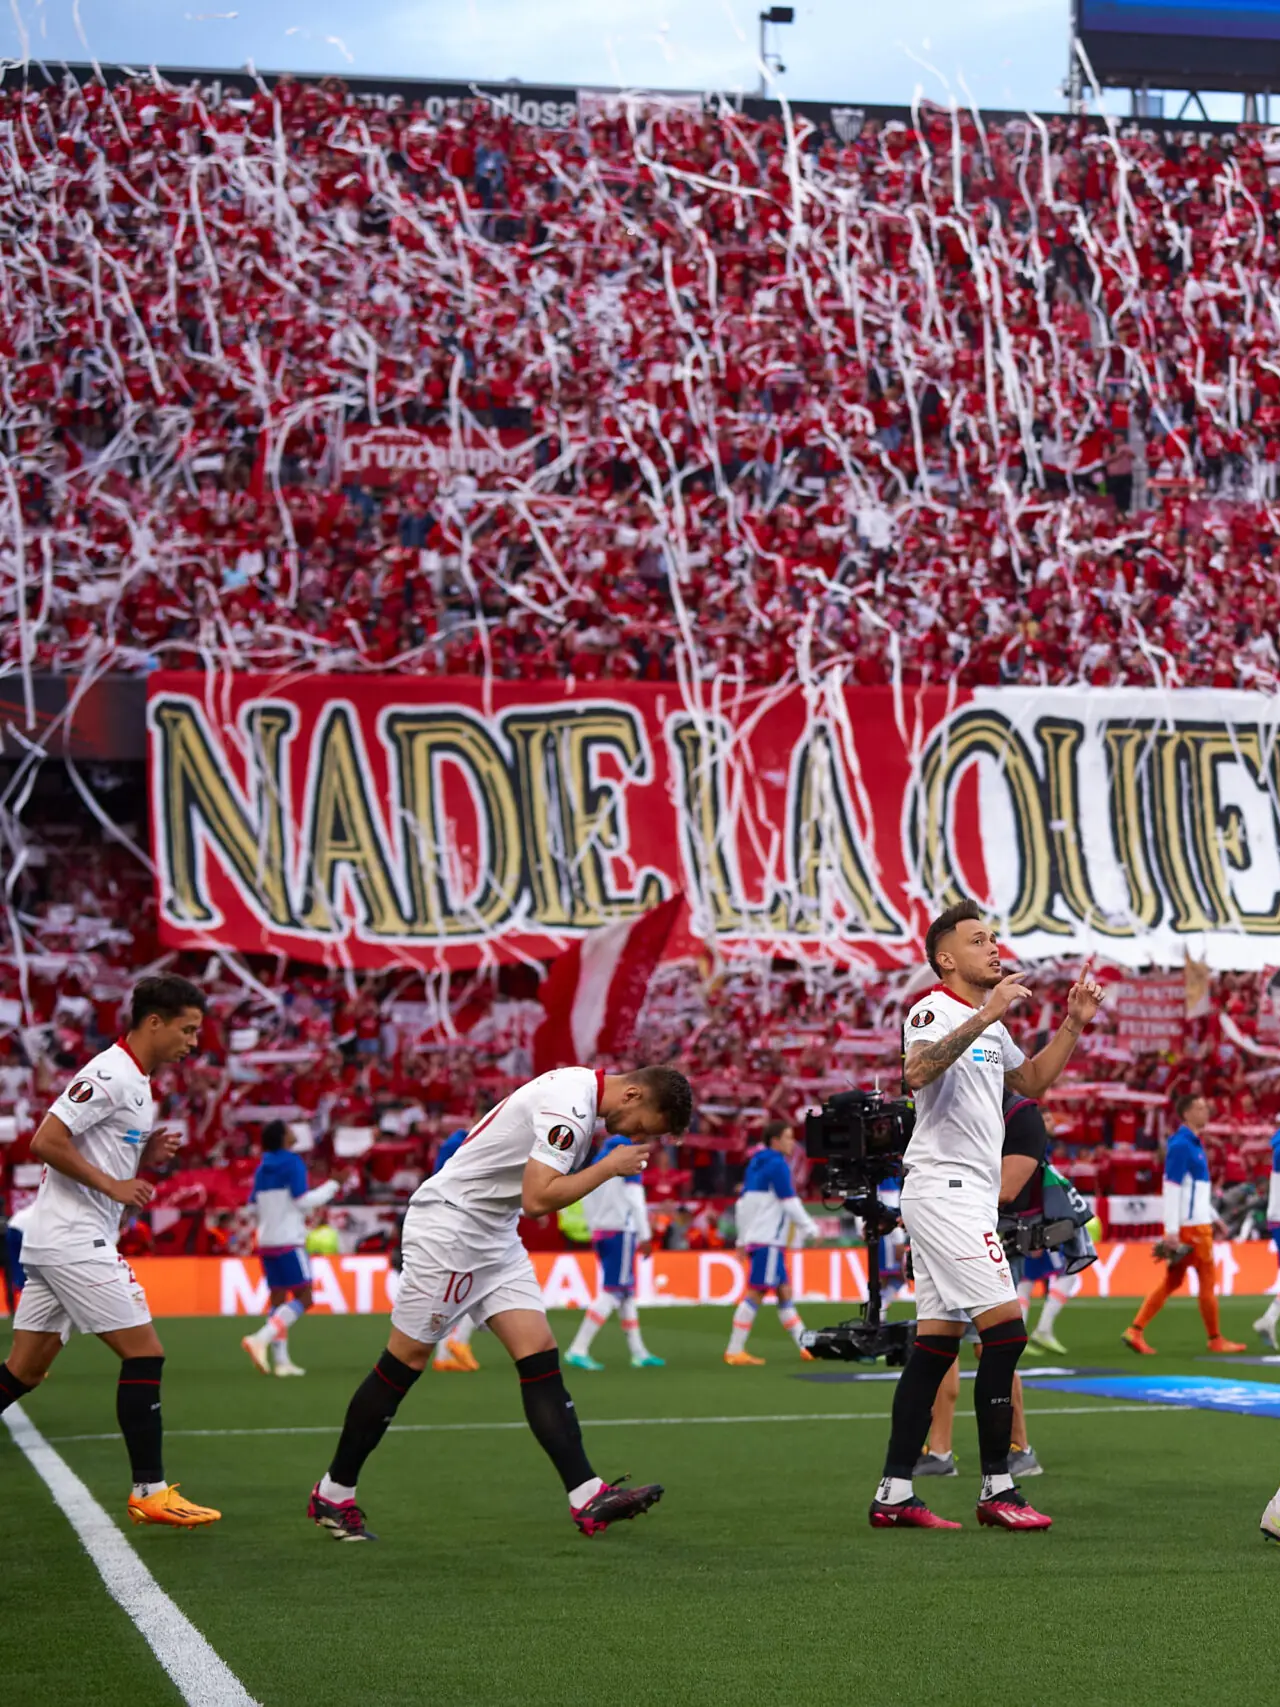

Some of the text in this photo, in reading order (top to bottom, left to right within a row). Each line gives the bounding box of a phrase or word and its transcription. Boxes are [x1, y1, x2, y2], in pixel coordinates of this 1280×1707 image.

[150, 695, 666, 938] NADIE
[669, 712, 909, 939] LA
[983, 1232, 1003, 1264] 5
[443, 1271, 474, 1304] 10
